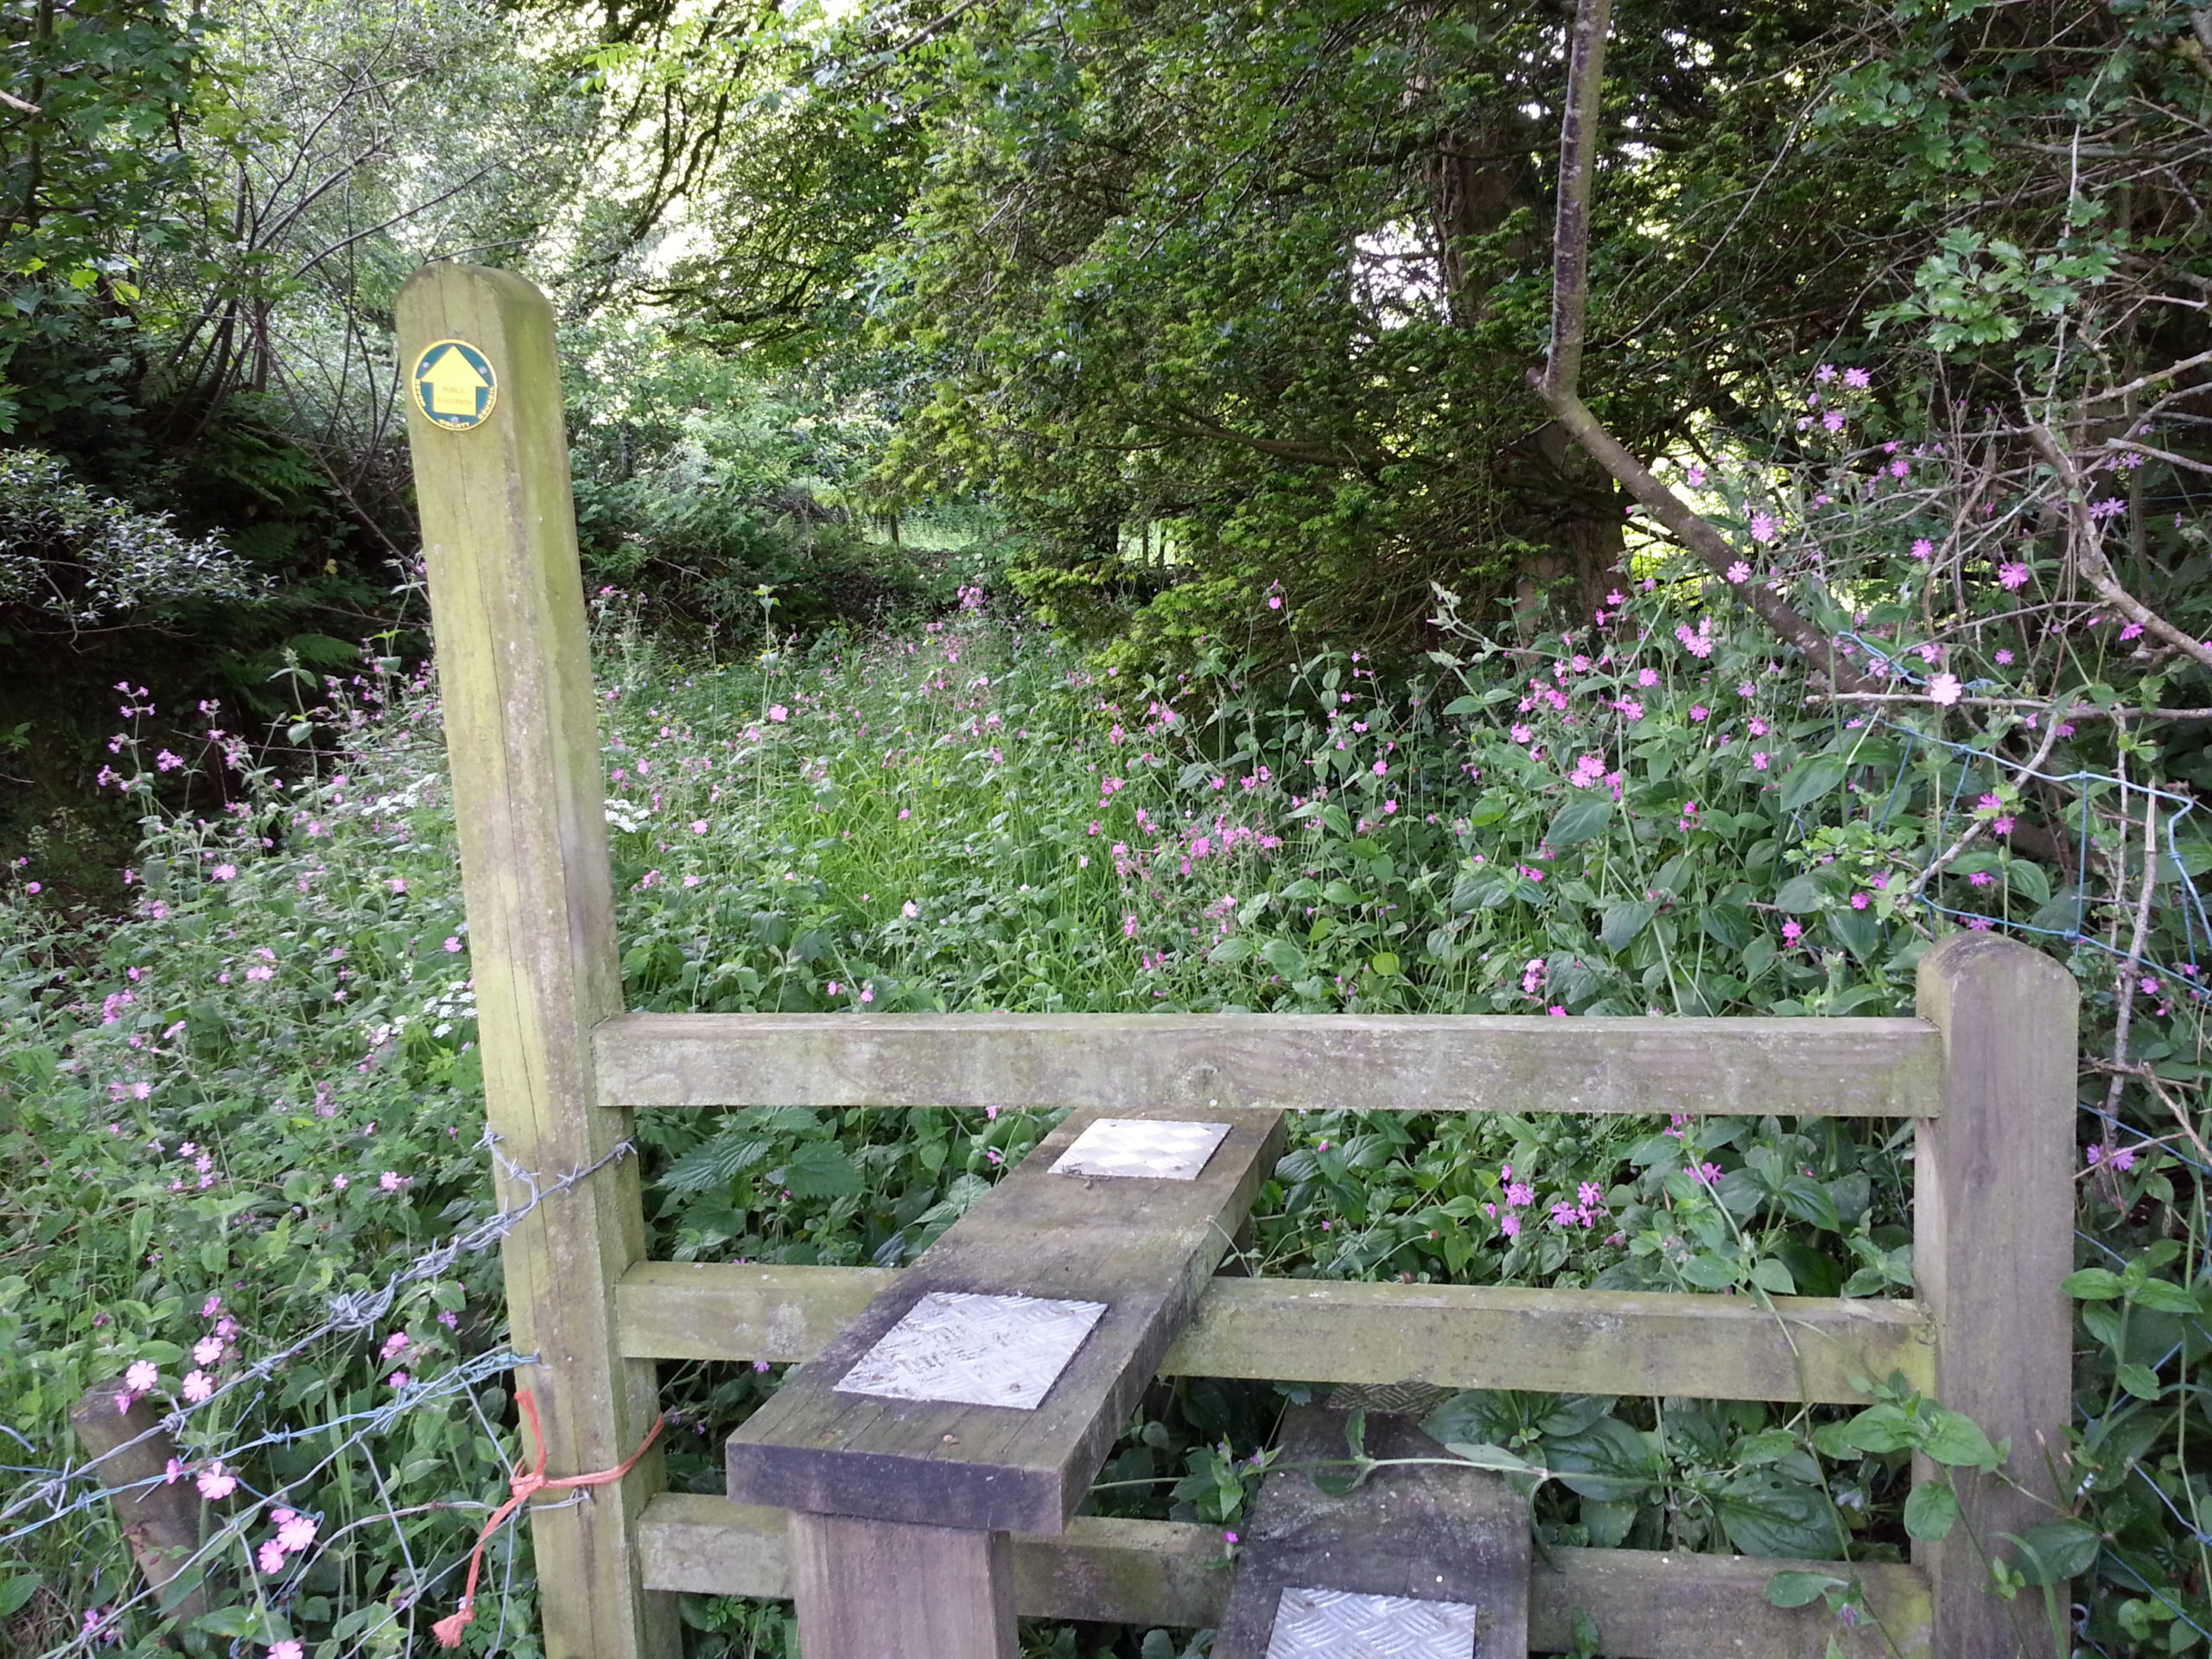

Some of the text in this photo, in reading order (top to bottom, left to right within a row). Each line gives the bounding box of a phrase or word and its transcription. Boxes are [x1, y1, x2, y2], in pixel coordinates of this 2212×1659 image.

[442, 385, 466, 394] PUBLIC
[437, 397, 474, 405] FOOTPATH
[439, 419, 470, 429] COUNTY
[478, 386, 494, 420] COUNCIL
